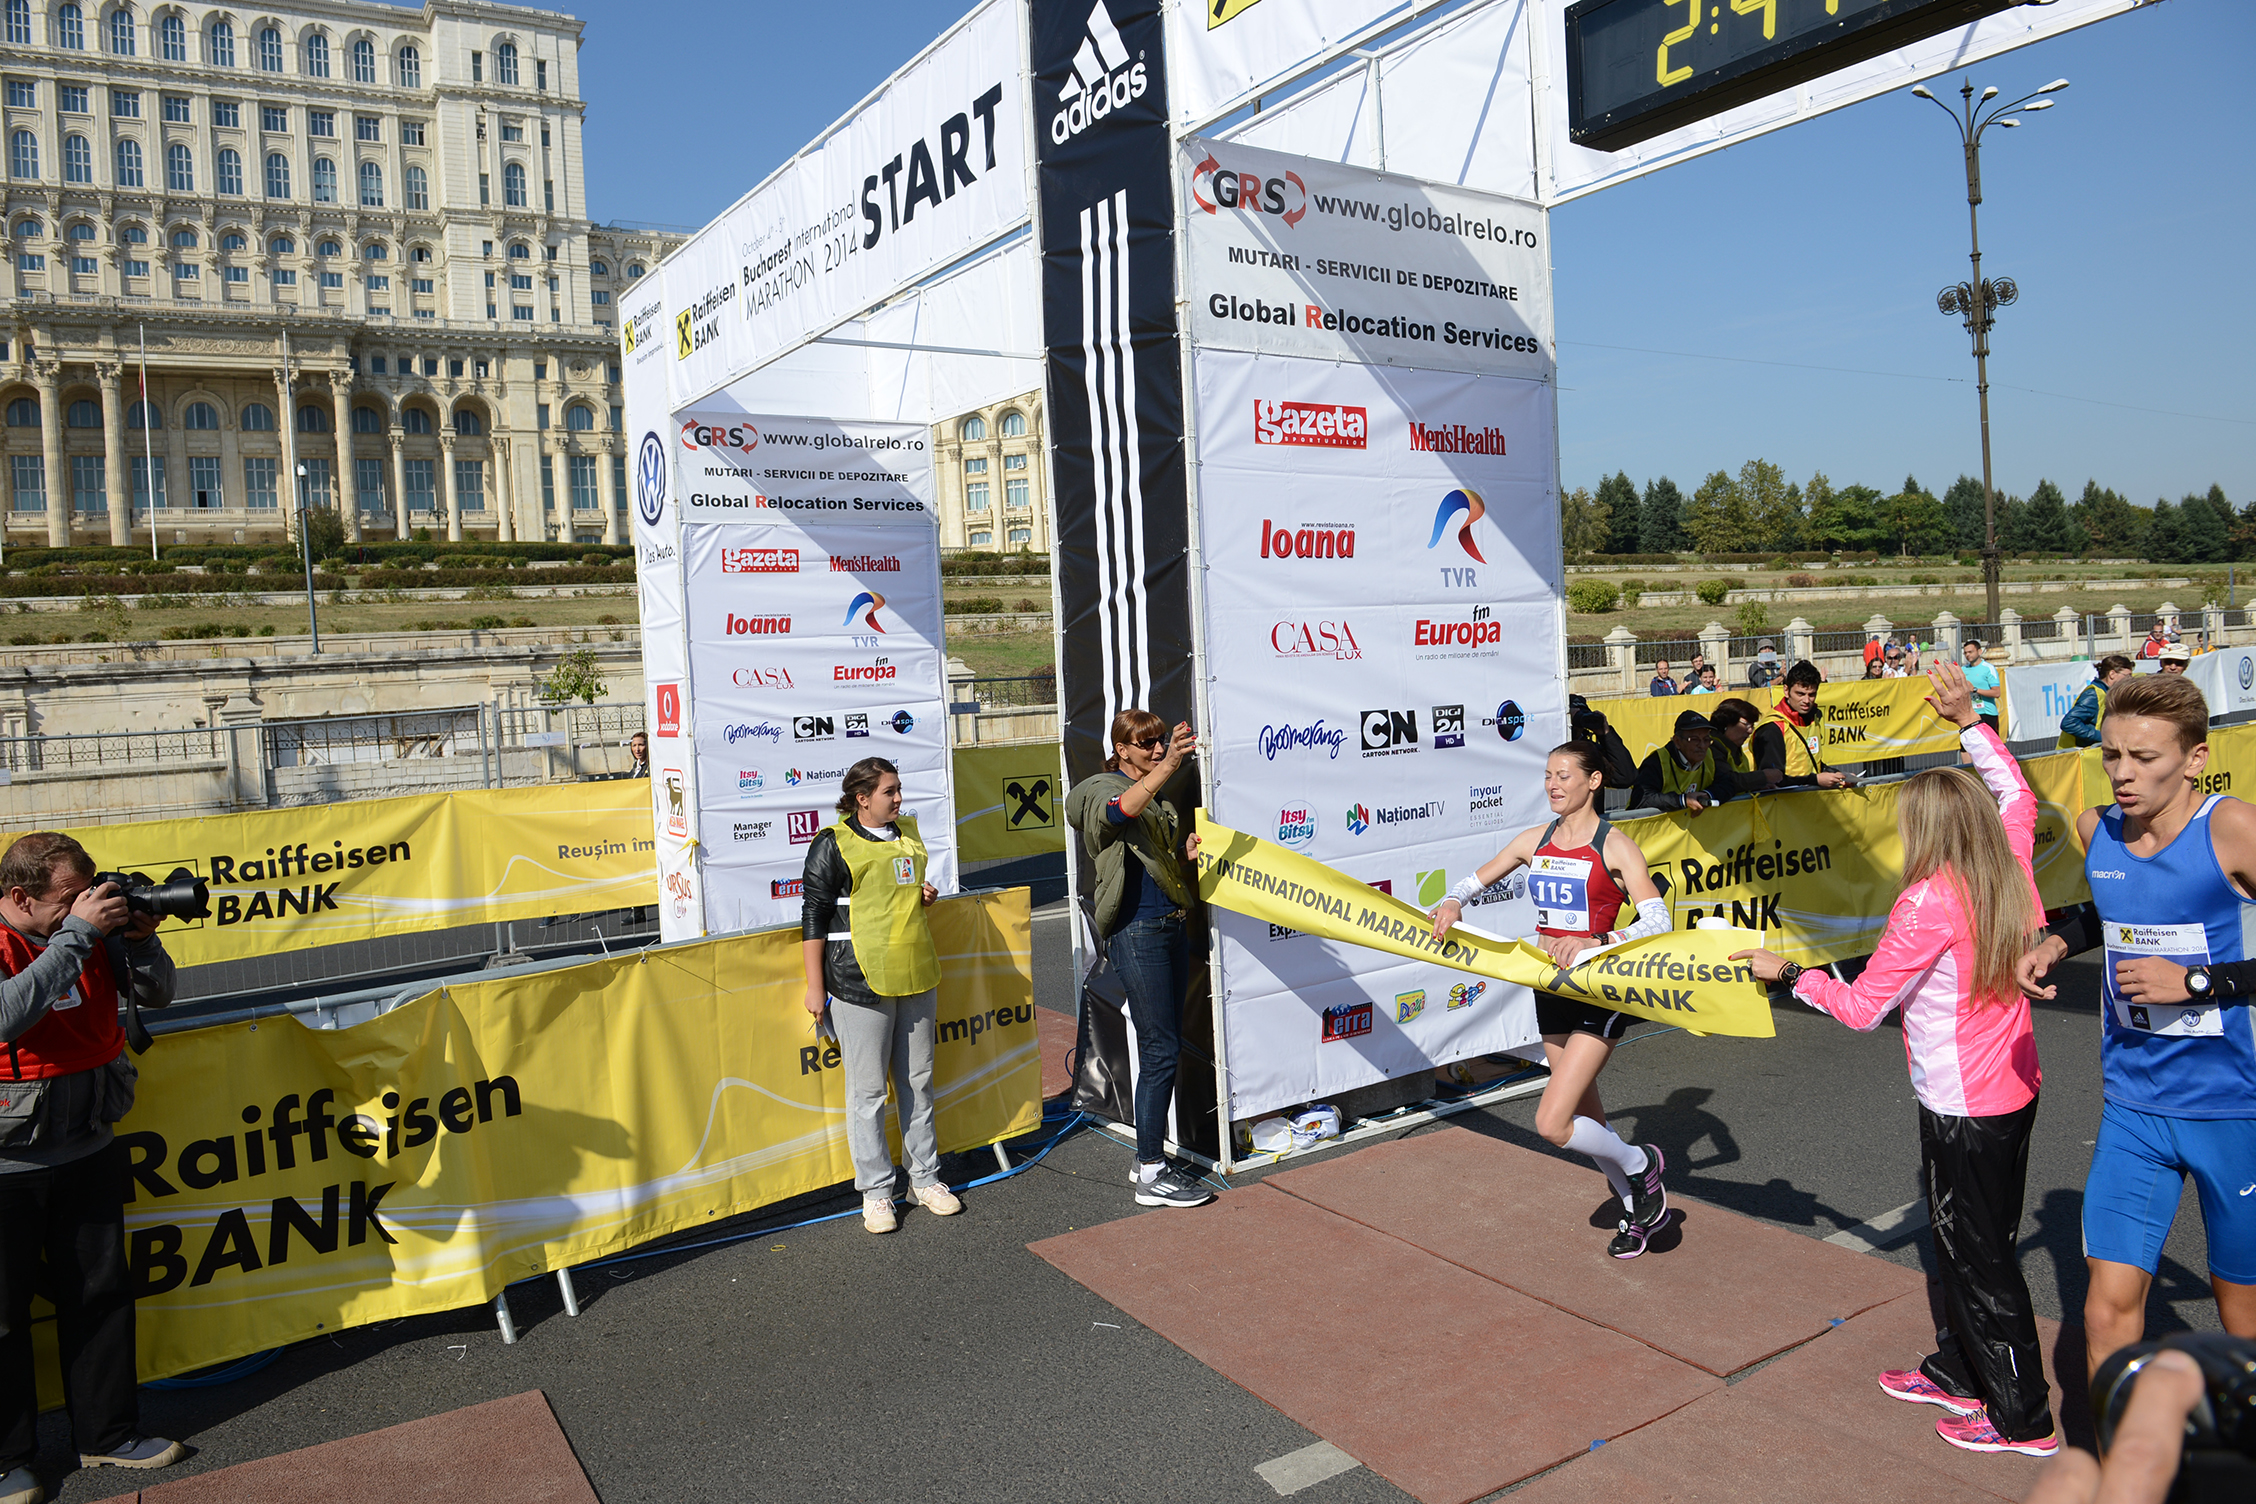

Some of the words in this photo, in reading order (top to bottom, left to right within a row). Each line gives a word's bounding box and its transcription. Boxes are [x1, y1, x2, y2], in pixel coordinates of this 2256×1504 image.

[1051, 62, 1147, 145] adidas
[861, 82, 1003, 250] START
[1212, 169, 1286, 214] GRS
[1314, 193, 1538, 250] www.globalrelo.ro
[743, 238, 791, 287] Bucharest
[793, 189, 856, 253] International
[746, 251, 815, 321] MARATHON
[825, 226, 858, 274] 2014
[1228, 246, 1300, 271] MUTARI
[1316, 259, 1391, 284] SERVICII
[1397, 270, 1417, 287] DE
[1422, 273, 1518, 302] DEPOZITARE
[692, 282, 736, 324] Raiffeisen
[633, 301, 662, 329] Raiffeisen
[1209, 293, 1295, 327] Global
[1305, 304, 1435, 343] Relocation
[1443, 322, 1538, 355] Services
[635, 324, 652, 348] BANK
[694, 315, 720, 351] BANK
[1258, 399, 1364, 444] gazeta
[694, 425, 744, 448] GRS
[763, 433, 924, 451] www.globalrelo.ro
[704, 467, 752, 478] MUTARI
[764, 469, 815, 480] SERVICII
[819, 471, 835, 481] DE
[838, 471, 909, 482] DEPOZITARE
[691, 493, 749, 508] Global
[755, 495, 848, 510] Relocation
[853, 497, 924, 512] Services
[1260, 519, 1355, 558] Ioana
[724, 549, 797, 572] gazeta
[1440, 567, 1477, 588] TVR
[726, 613, 791, 635] Ioana
[1473, 605, 1490, 622] fm
[852, 636, 879, 648] TVR
[1271, 620, 1361, 653] CASA
[1336, 650, 1362, 660] LUX
[1415, 619, 1501, 648] Europa
[834, 665, 896, 681] Europa
[875, 656, 888, 667] fm
[732, 667, 793, 686] CASA
[776, 682, 795, 691] LUX
[1435, 708, 1461, 716] DIGI
[1828, 703, 1890, 722] Raiffeisen
[723, 721, 785, 744] Boomerang
[848, 721, 866, 733] 24
[1436, 719, 1461, 739] 24
[1829, 724, 1867, 745] BANK
[1258, 718, 1348, 761] Boomerang
[1362, 750, 1390, 759] CARTOON
[739, 778, 763, 788] Bitsy
[740, 770, 758, 780] Itsy
[1470, 796, 1503, 813] pocket
[733, 821, 773, 833] Manager
[789, 813, 819, 836] RL
[1280, 809, 1306, 825] Itsy
[1469, 812, 1504, 821] ESSENTIAL
[733, 830, 767, 841] Express
[1278, 823, 1314, 841] Bitsy
[558, 839, 626, 861] Reușim
[211, 840, 412, 886] Raiffeisen
[1681, 839, 1831, 895] Raiffeisen
[666, 871, 692, 900] URSUS
[2092, 869, 2126, 881] macron
[216, 881, 341, 926] BANK
[1537, 881, 1573, 905] 115
[1217, 857, 1351, 923] INTERNATIONAL
[1357, 907, 1479, 967] MARATHON
[2133, 928, 2177, 937] Raiffeisen
[2135, 938, 2161, 946] BANK
[1597, 952, 1755, 983] Raiffeisen
[1602, 983, 1697, 1013] BANK
[1322, 1006, 1371, 1037] terra
[115, 1075, 522, 1198] Raiffeisen
[131, 1180, 399, 1299] BANK
